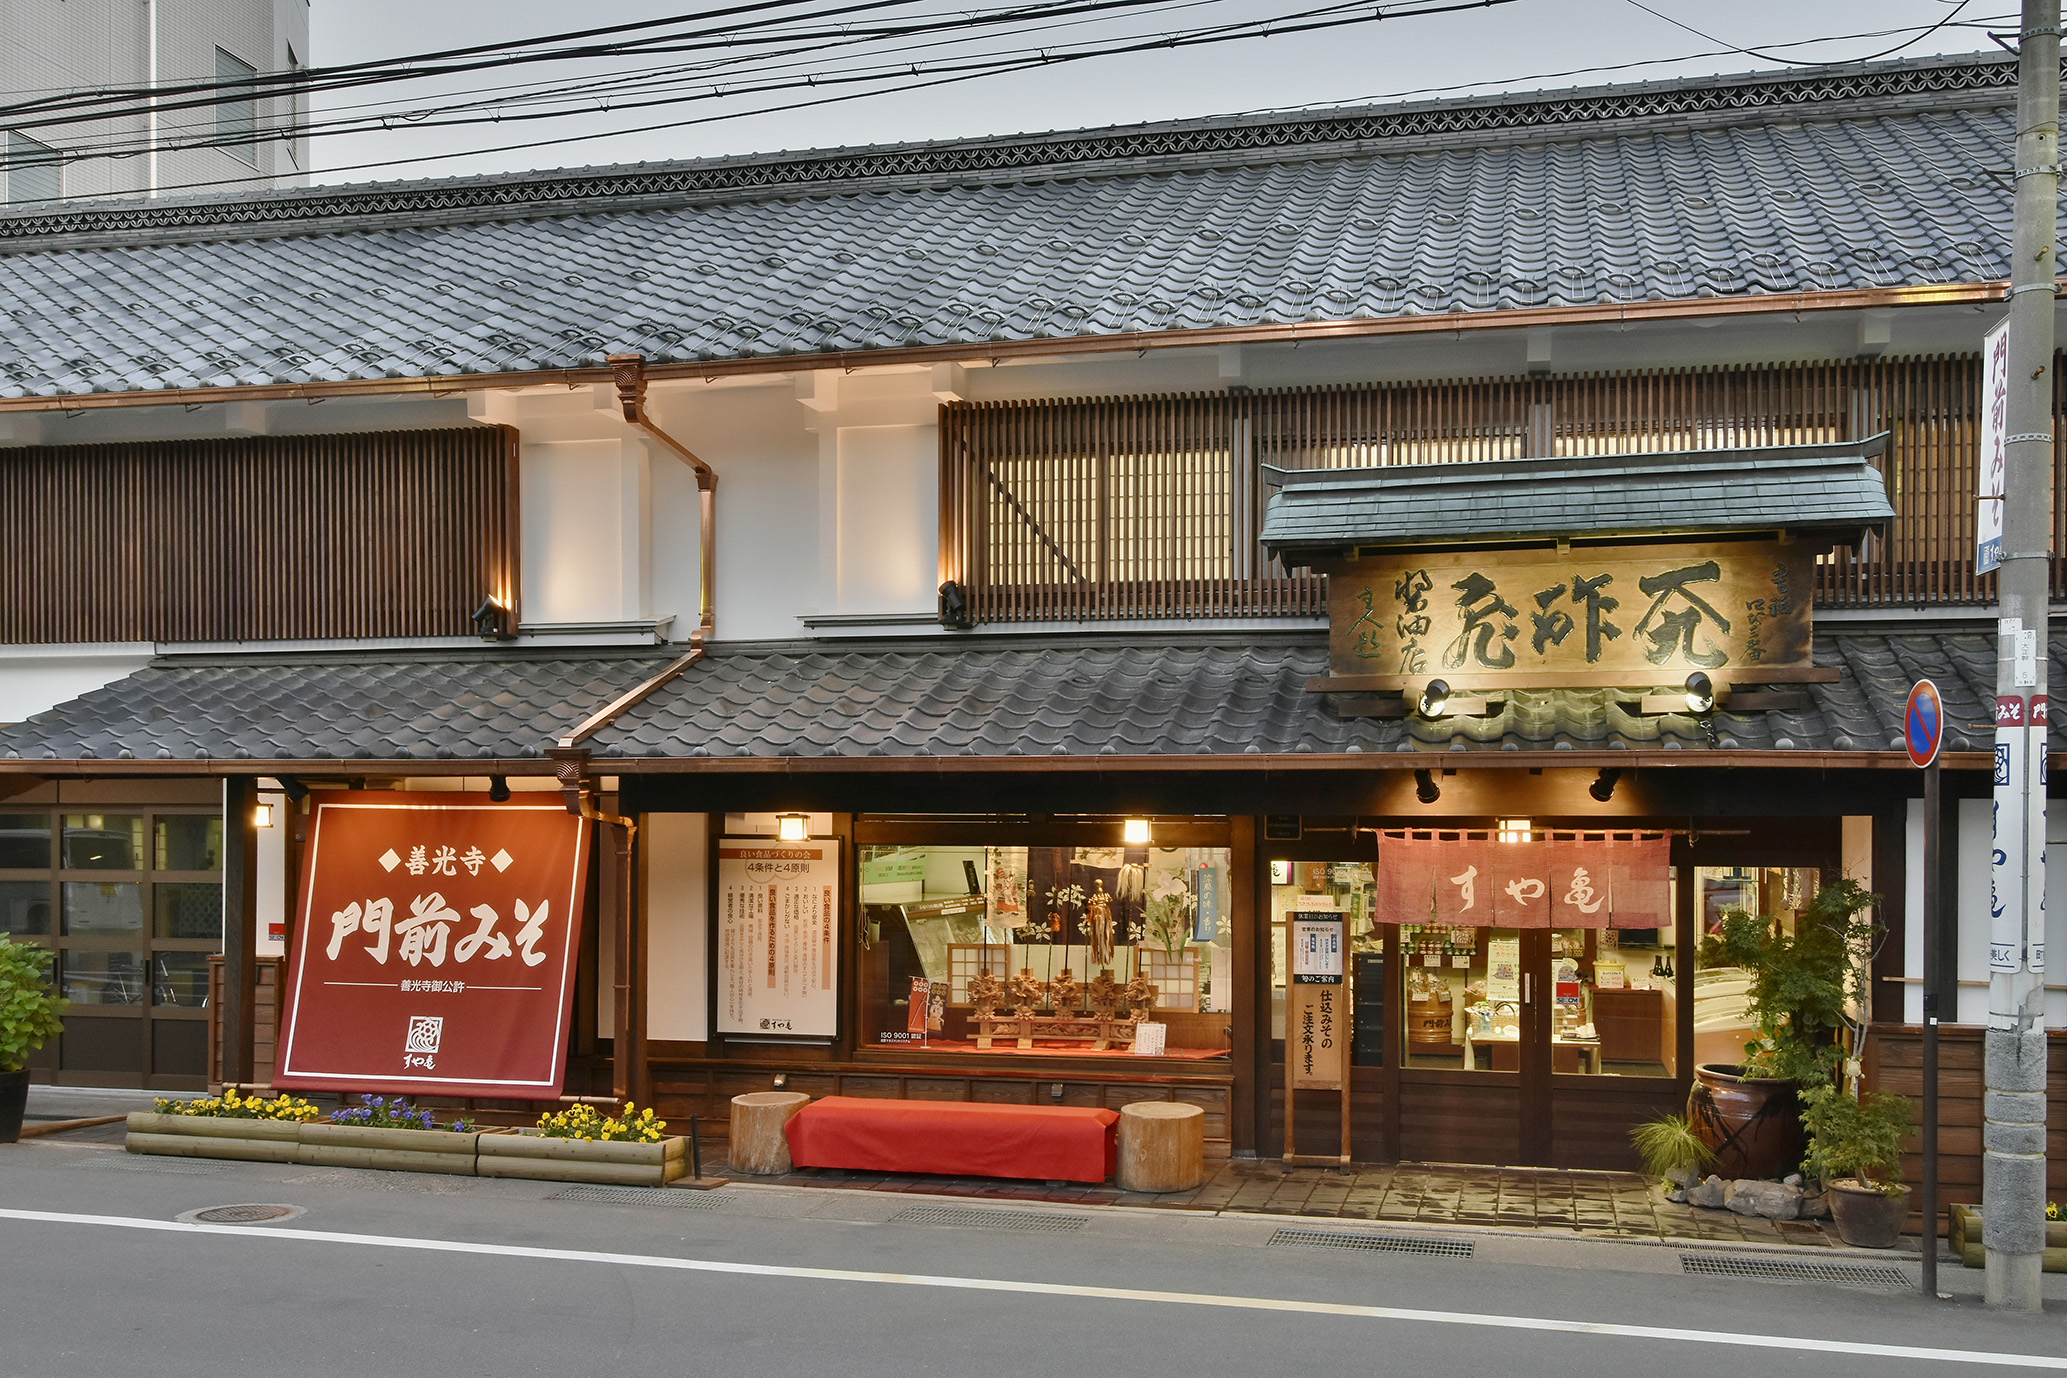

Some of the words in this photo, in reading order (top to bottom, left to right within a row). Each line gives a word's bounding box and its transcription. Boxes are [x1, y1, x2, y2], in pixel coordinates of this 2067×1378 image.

[405, 845, 486, 877] 善光寺
[739, 849, 811, 860] 良い食品づくりの会
[747, 862, 810, 874] 4条件と4原則
[1450, 864, 1605, 914] すや亀
[326, 892, 549, 967] 門前みそ
[400, 979, 465, 994] 善光寺御公許
[1320, 989, 1333, 1050] 仕込みその
[1302, 1005, 1315, 1076] ご注文承ります。
